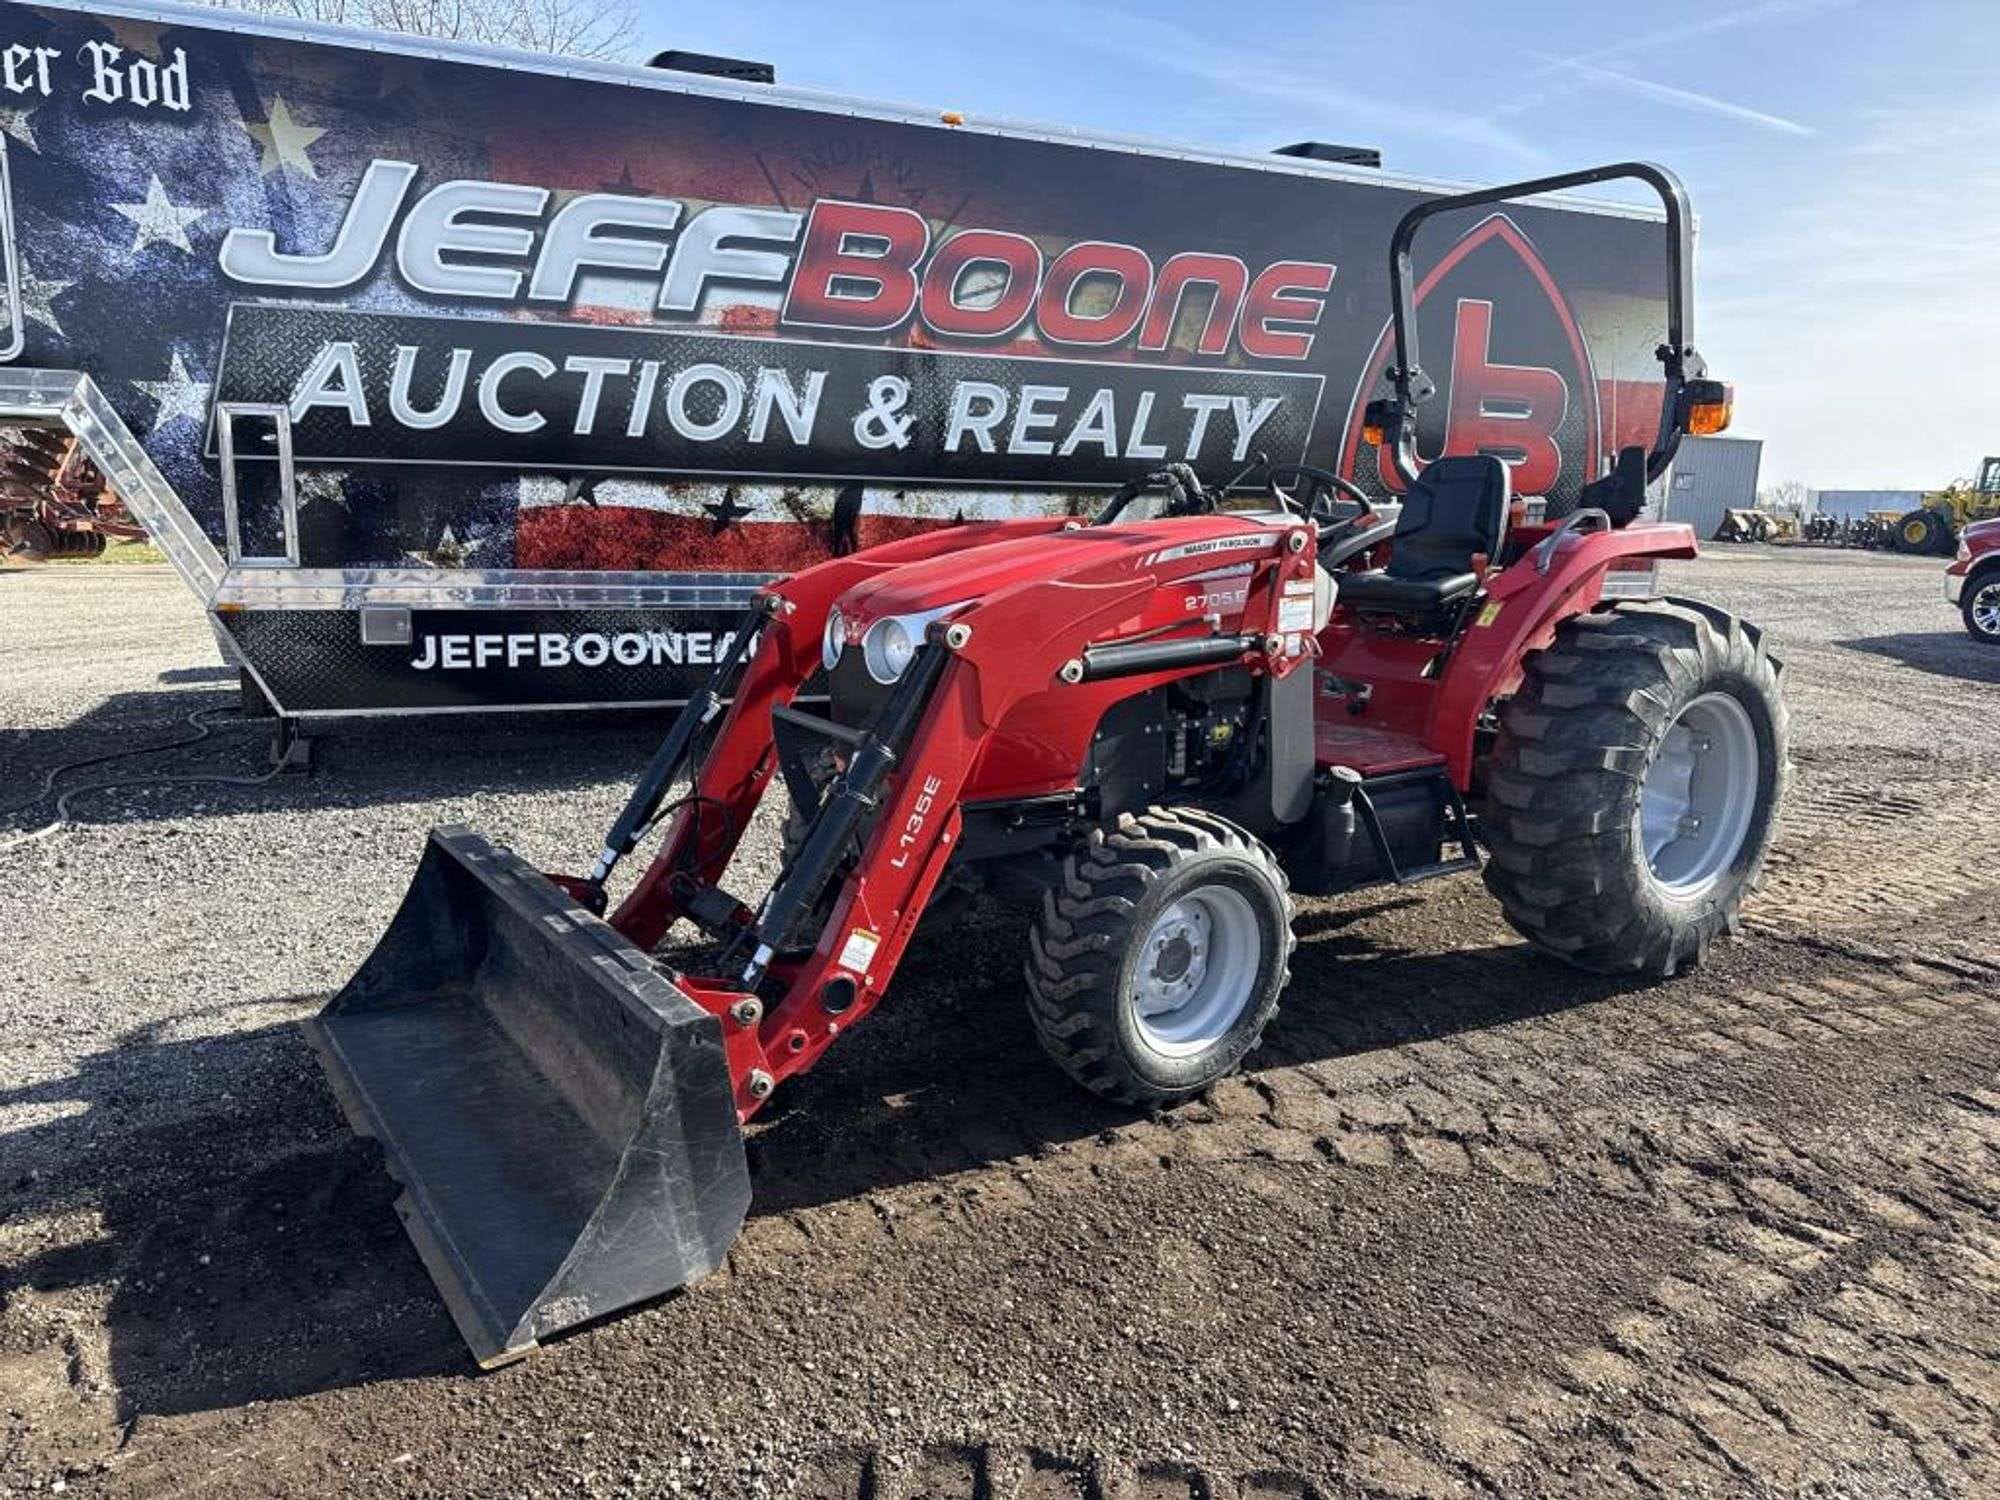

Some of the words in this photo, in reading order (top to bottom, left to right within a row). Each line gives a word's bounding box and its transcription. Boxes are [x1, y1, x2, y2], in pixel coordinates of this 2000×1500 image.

[288, 341, 828, 447] AUCTION
[853, 375, 913, 451] &
[944, 379, 1282, 462] REALTY
[411, 629, 763, 670] JEFFBOONEA
